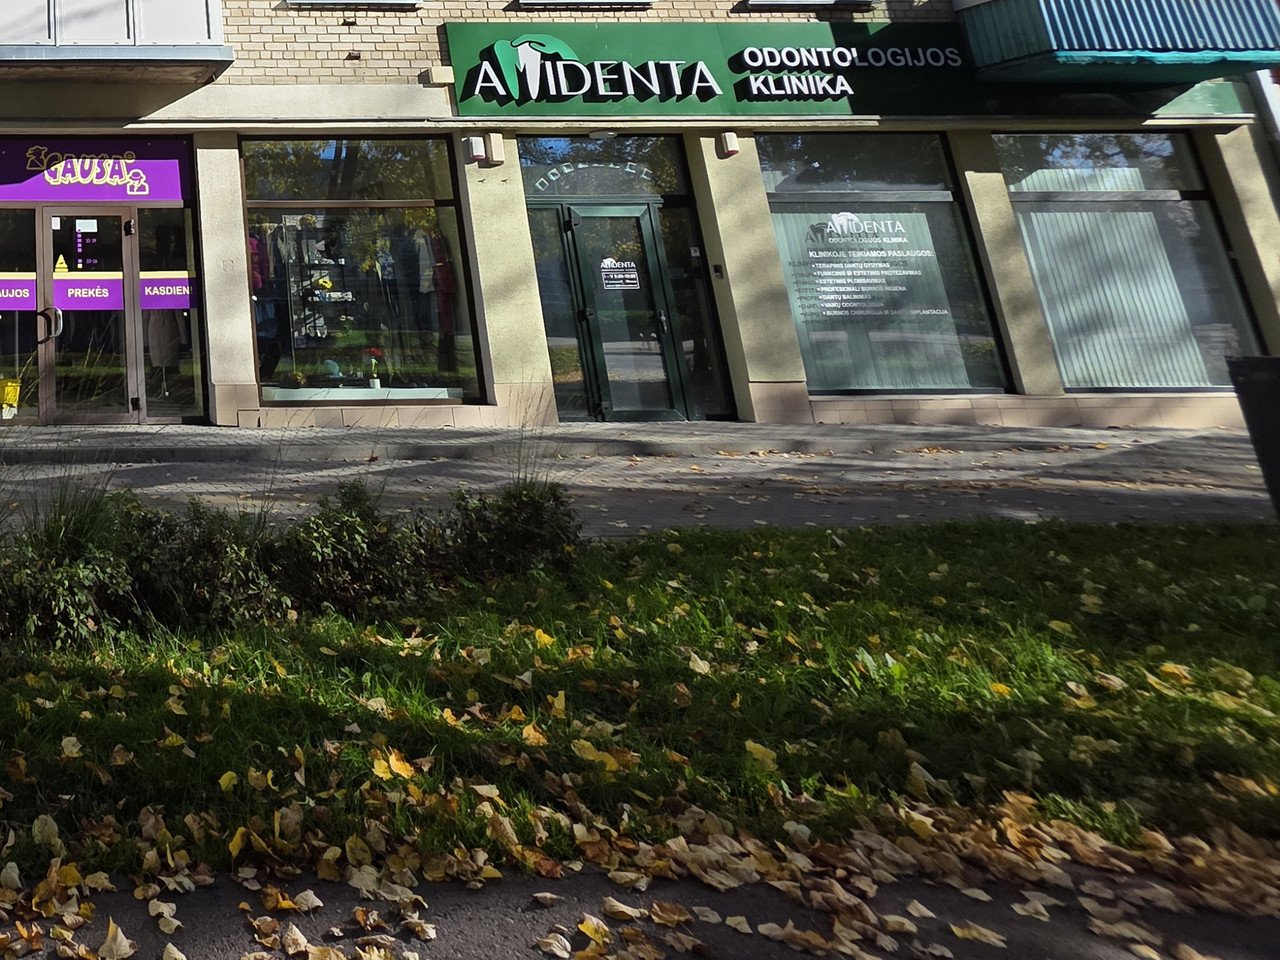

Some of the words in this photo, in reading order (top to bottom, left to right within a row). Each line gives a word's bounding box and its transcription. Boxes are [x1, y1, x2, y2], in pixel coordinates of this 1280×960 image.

[743, 46, 962, 67] ODONTOLOGIJOS
[749, 74, 855, 95] KLINIKA
[67, 285, 109, 297] PREKĖS
[144, 286, 193, 295] KASDIEN!
